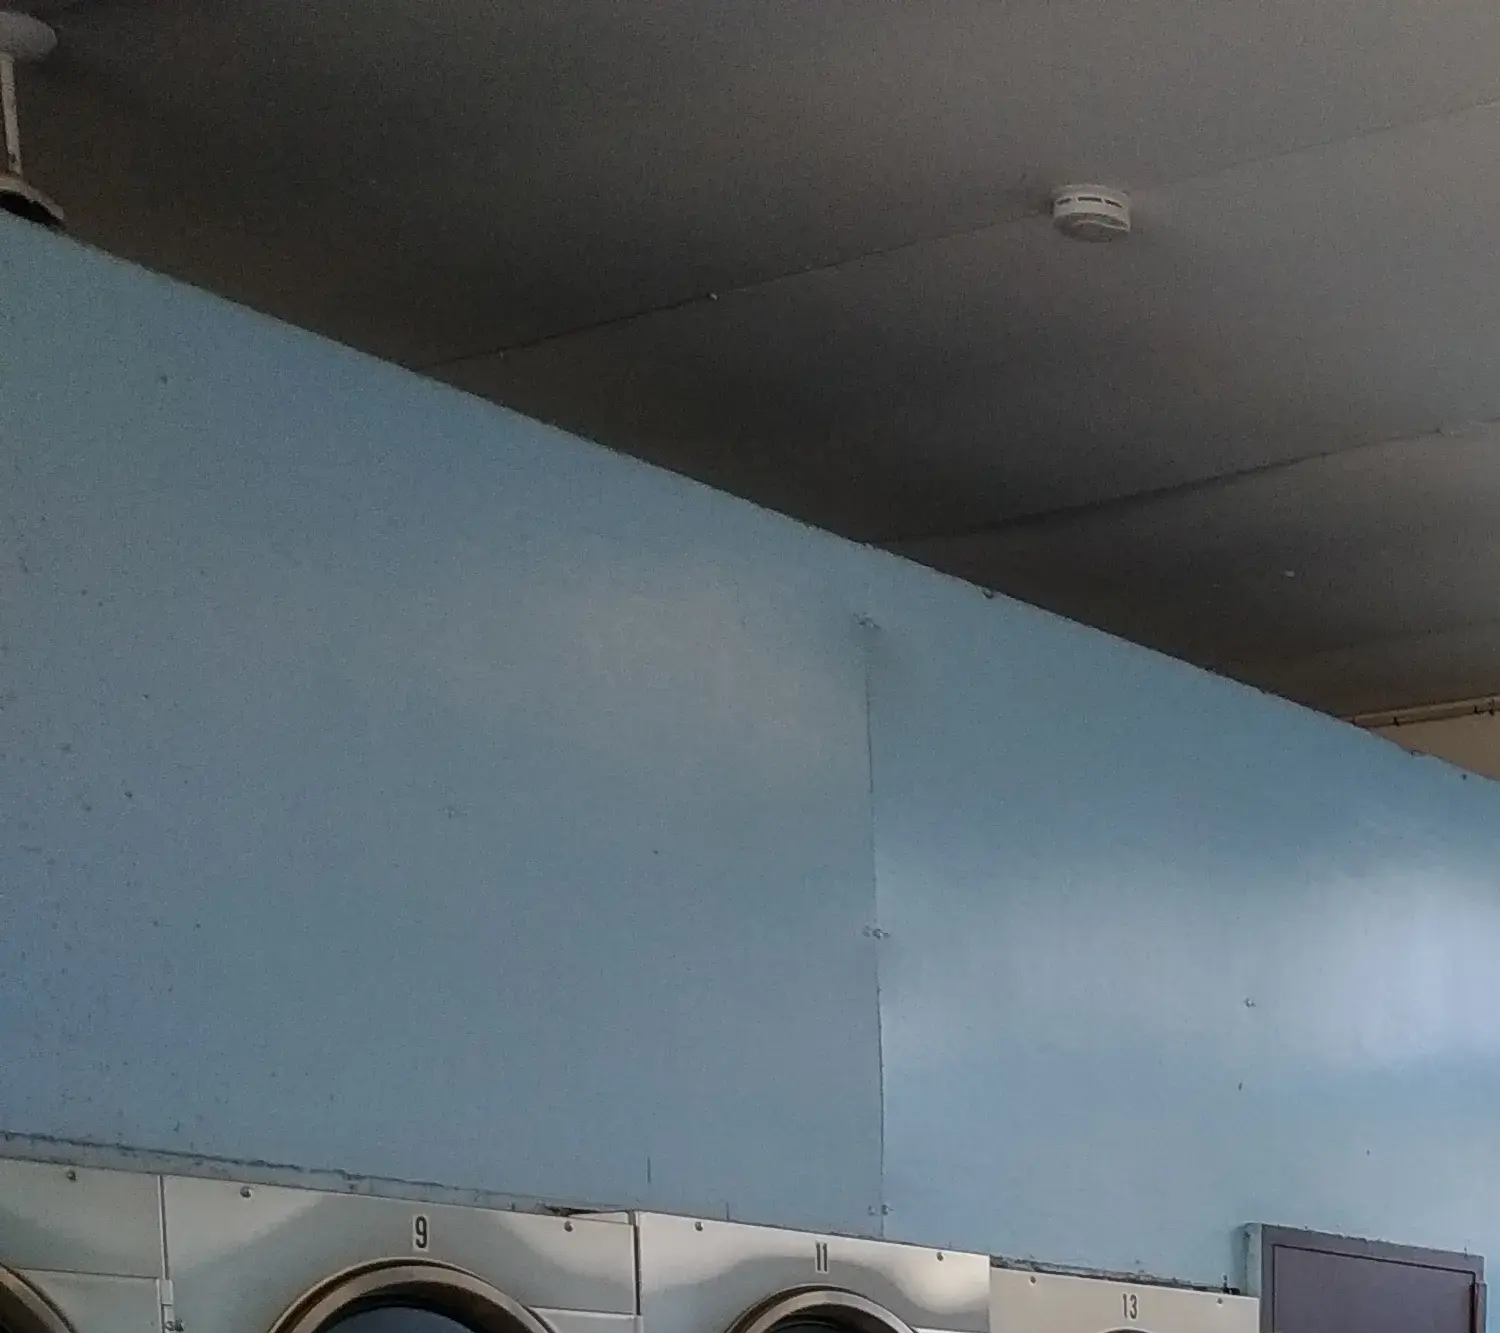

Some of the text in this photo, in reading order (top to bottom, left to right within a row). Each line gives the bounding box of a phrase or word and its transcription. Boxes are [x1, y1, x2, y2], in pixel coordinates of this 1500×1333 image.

[415, 1216, 428, 1249] 9
[815, 1242, 829, 1273] 11
[1122, 1293, 1138, 1320] 13
